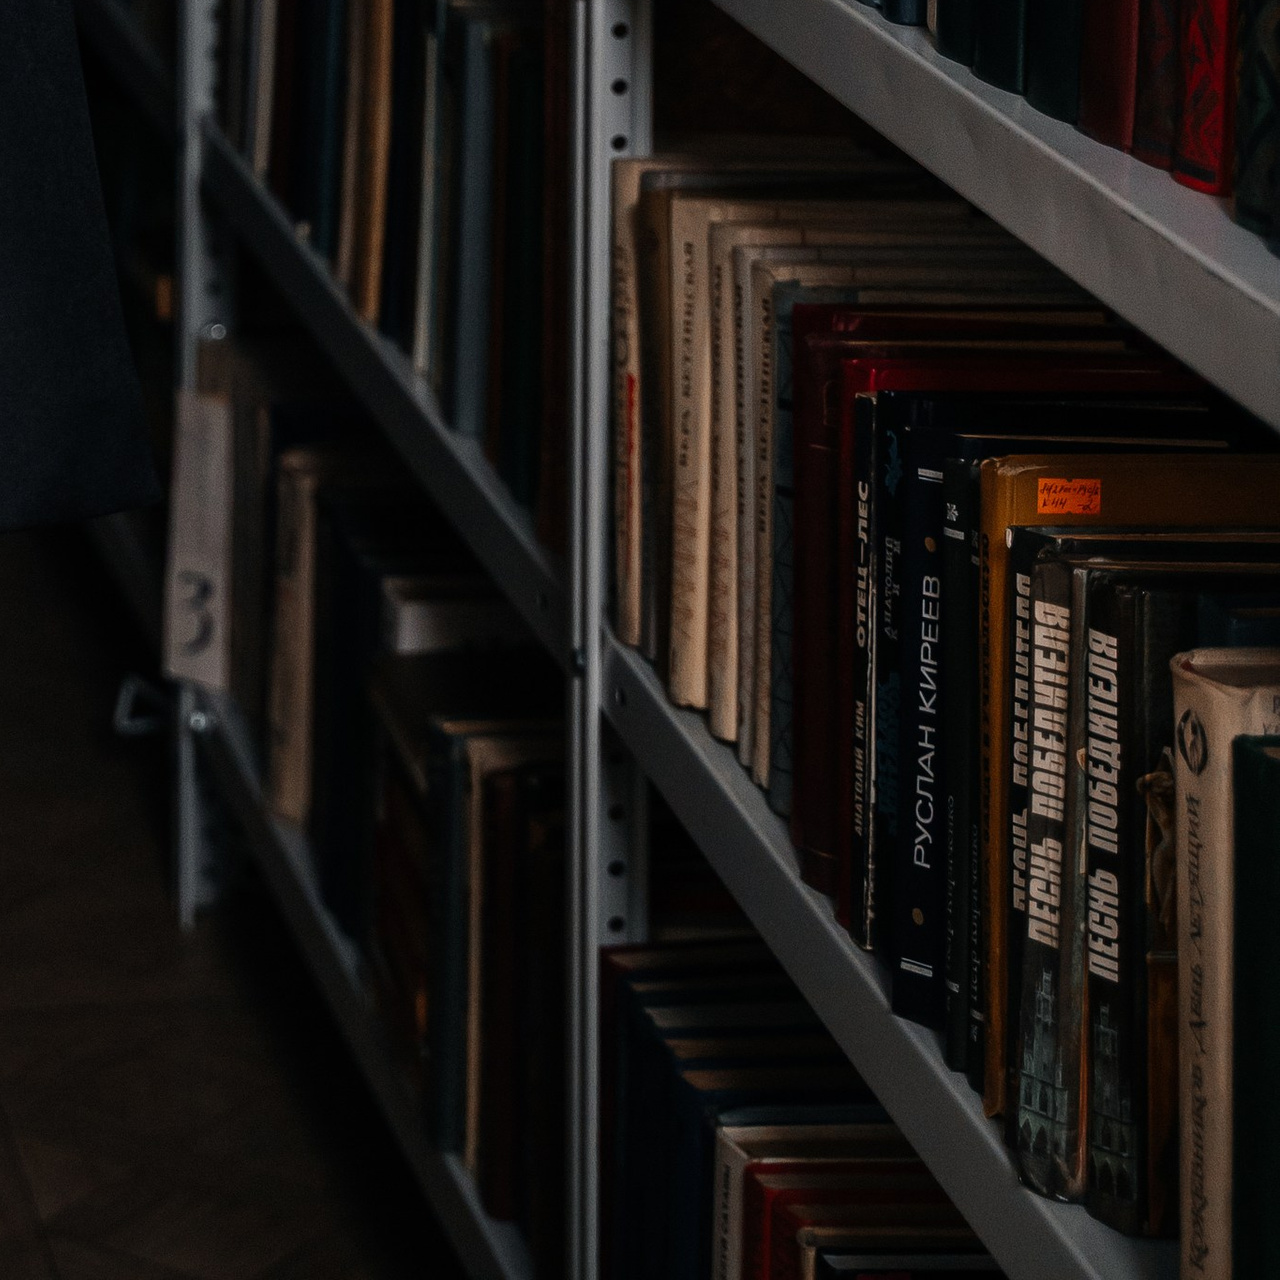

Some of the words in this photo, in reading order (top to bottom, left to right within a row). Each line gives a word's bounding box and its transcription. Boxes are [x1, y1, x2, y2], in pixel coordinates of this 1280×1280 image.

[918, 574, 942, 714] КИРЕЕВ
[854, 699, 865, 740] КИМ
[1031, 600, 1071, 822] ПОБЕДИТЕЛЯ
[1088, 628, 1122, 855] ПОБЕДИТЕЛЯ
[854, 746, 865, 837] АНАТОЛИЙ
[914, 724, 937, 870] РУСЛАН
[1028, 836, 1063, 950] ПЕСНЬ
[1088, 868, 1119, 984] ПЕСНЬ
